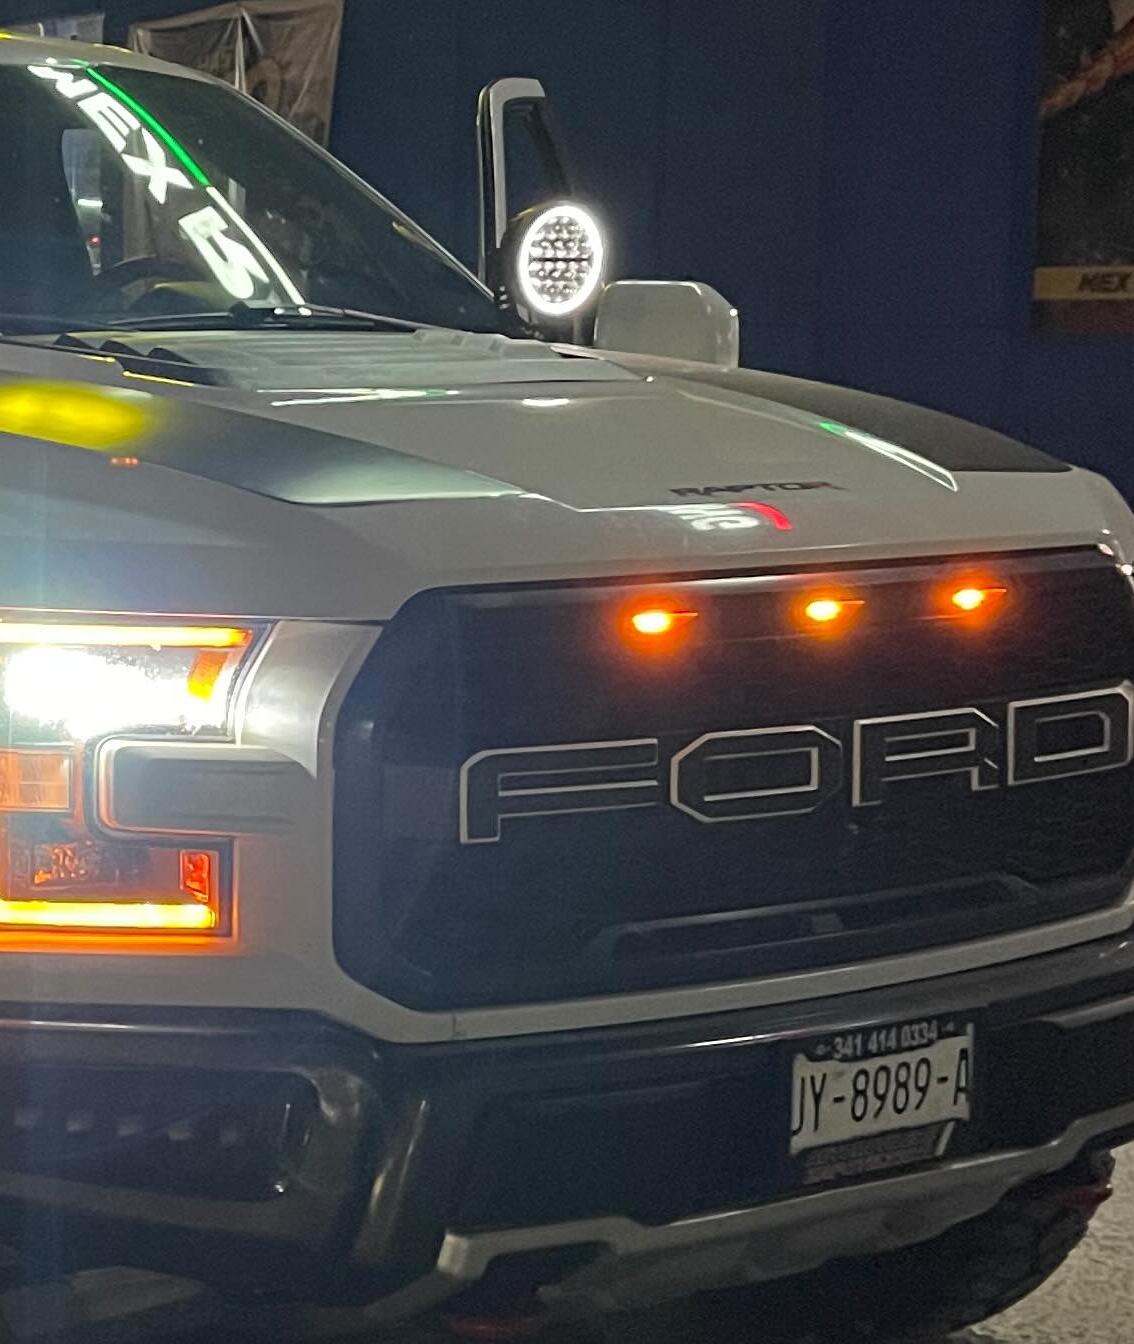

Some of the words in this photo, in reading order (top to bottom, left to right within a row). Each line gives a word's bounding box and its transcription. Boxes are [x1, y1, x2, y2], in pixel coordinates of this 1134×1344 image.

[667, 481, 851, 497] RAPTOR
[459, 685, 1134, 845] FORD
[791, 1047, 968, 1137] JY-8989-A
